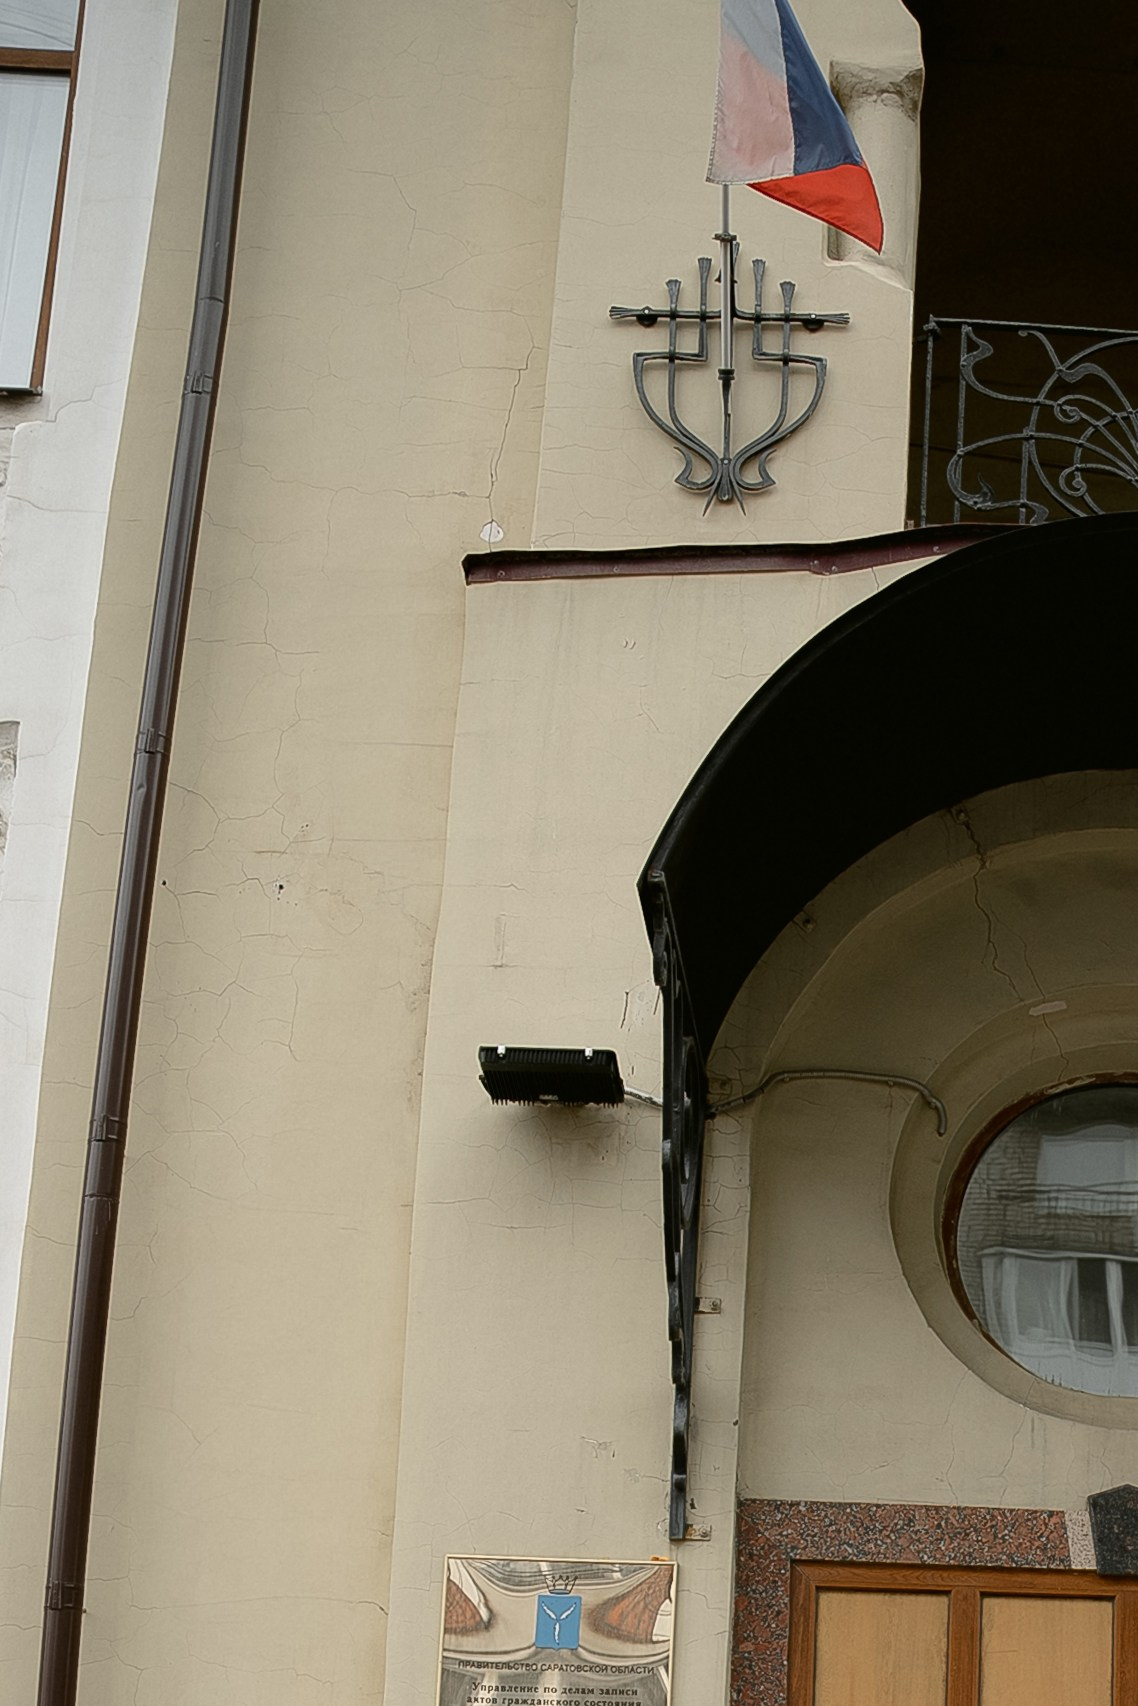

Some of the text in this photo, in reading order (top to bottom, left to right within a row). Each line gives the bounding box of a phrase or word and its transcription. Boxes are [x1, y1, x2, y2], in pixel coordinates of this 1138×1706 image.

[458, 1661, 655, 1675] ПРАВИТЕЛЬСТВО САРАТОВСКОЙ ОБЛАСТИ
[472, 1682, 539, 1694] Управление
[560, 1686, 595, 1695] делам
[598, 1688, 638, 1696] записи
[466, 1696, 498, 1705] актов
[502, 1697, 581, 1706] гражданского
